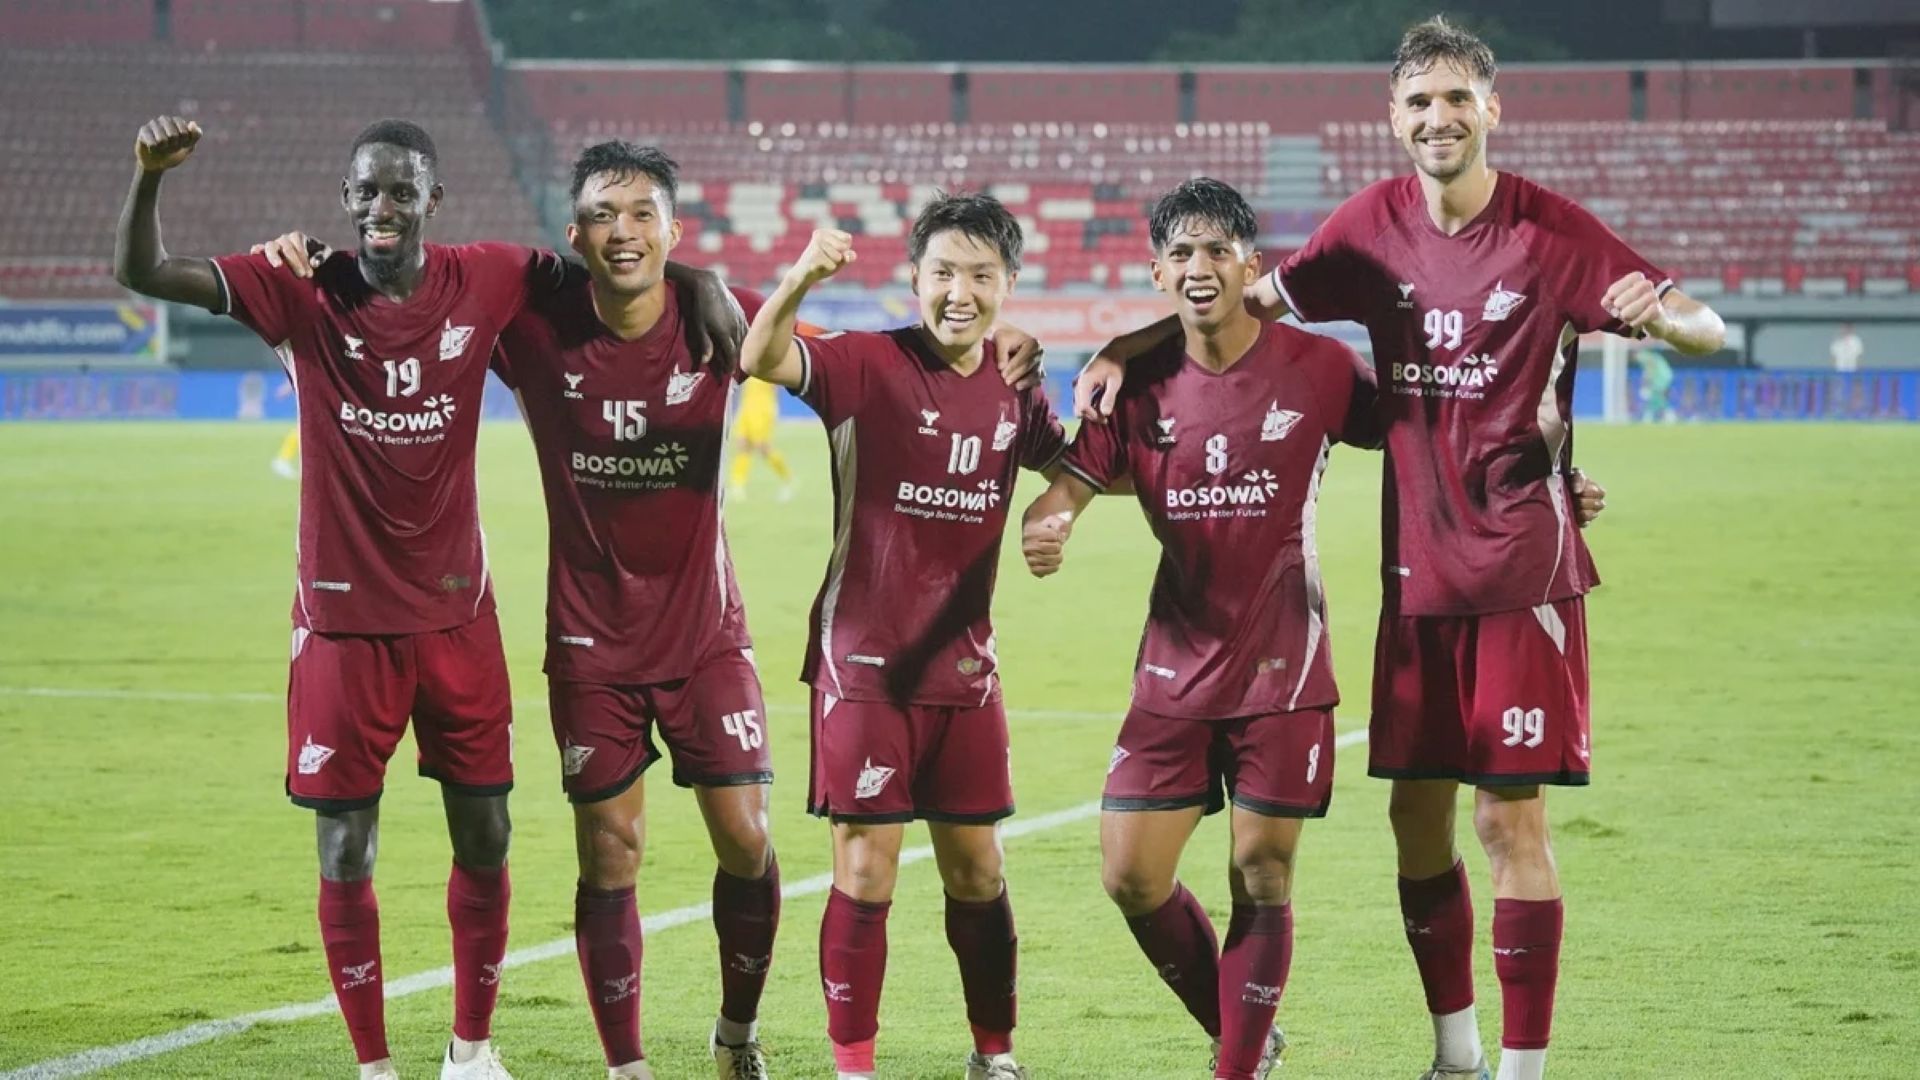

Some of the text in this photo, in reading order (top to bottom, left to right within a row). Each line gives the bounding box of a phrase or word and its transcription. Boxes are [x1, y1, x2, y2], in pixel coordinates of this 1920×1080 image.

[1423, 308, 1463, 351] 99
[383, 357, 421, 398] 19
[1392, 362, 1484, 387] BOSOWA
[1455, 389, 1485, 400] Future
[340, 400, 444, 432] BOSOWA
[602, 400, 648, 441] 45
[384, 434, 414, 445] Better
[415, 432, 445, 444] Future
[947, 432, 982, 475] 10
[1205, 432, 1228, 476] 8
[572, 452, 676, 476] BOSOWA
[615, 480, 644, 489] Better
[646, 480, 677, 489] Future
[898, 481, 986, 512] BOSOWA
[1167, 486, 1266, 508] BOSOWA
[935, 510, 958, 521] Better
[960, 513, 984, 524] Future
[1208, 509, 1234, 518] Better
[1236, 508, 1266, 517] Future
[722, 710, 763, 751] 45
[1502, 706, 1545, 749] 99
[1306, 744, 1320, 784] 8
